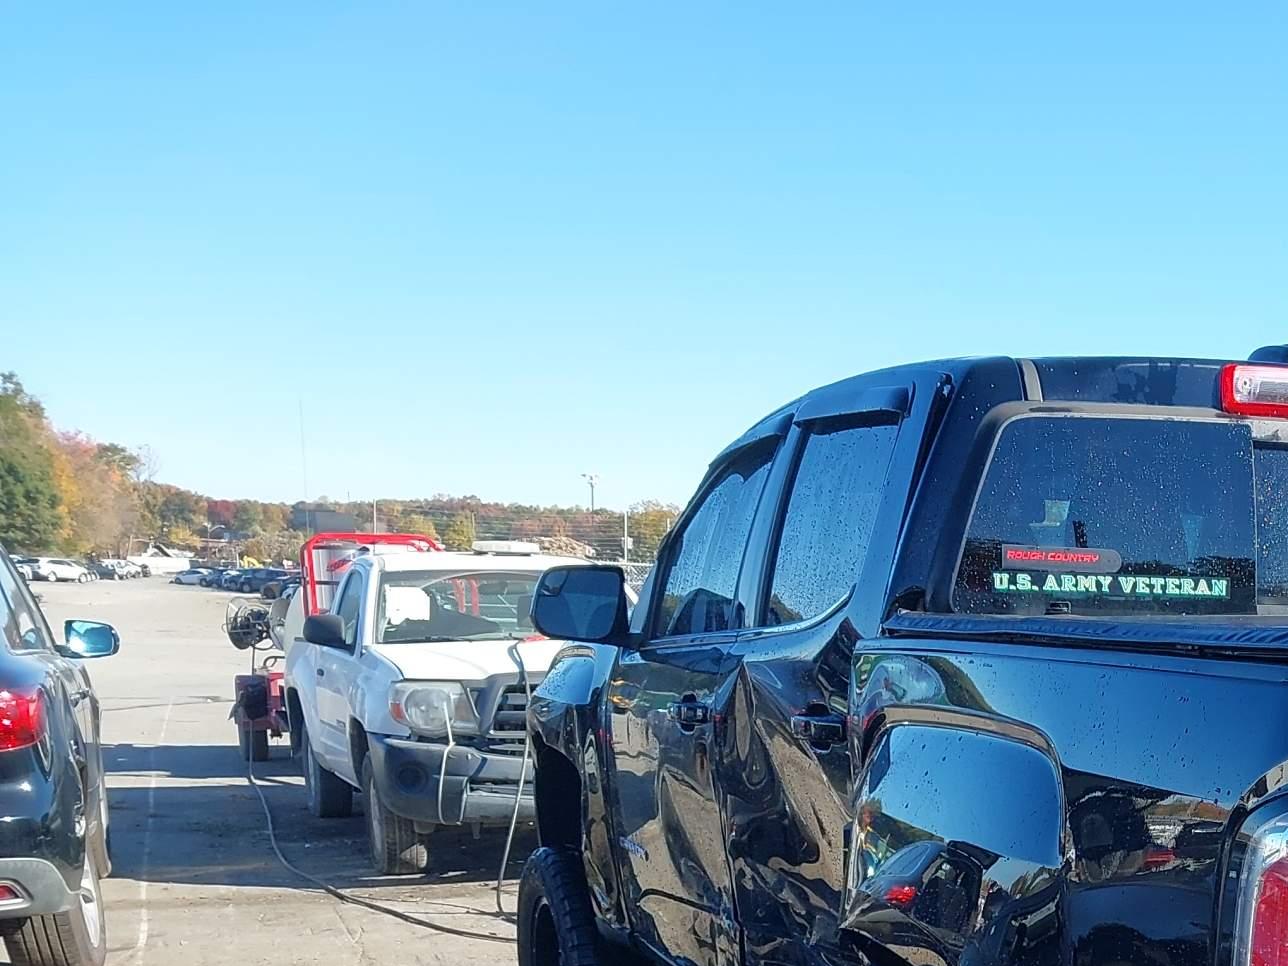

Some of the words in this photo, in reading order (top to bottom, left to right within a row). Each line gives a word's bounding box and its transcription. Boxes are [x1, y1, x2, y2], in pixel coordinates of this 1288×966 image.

[1006, 550, 1046, 562] ROUGH
[1047, 551, 1099, 564] COUNTRY
[992, 573, 1039, 593] U.S.
[1042, 574, 1113, 593] ARMY
[1118, 575, 1228, 597] VETERAN
